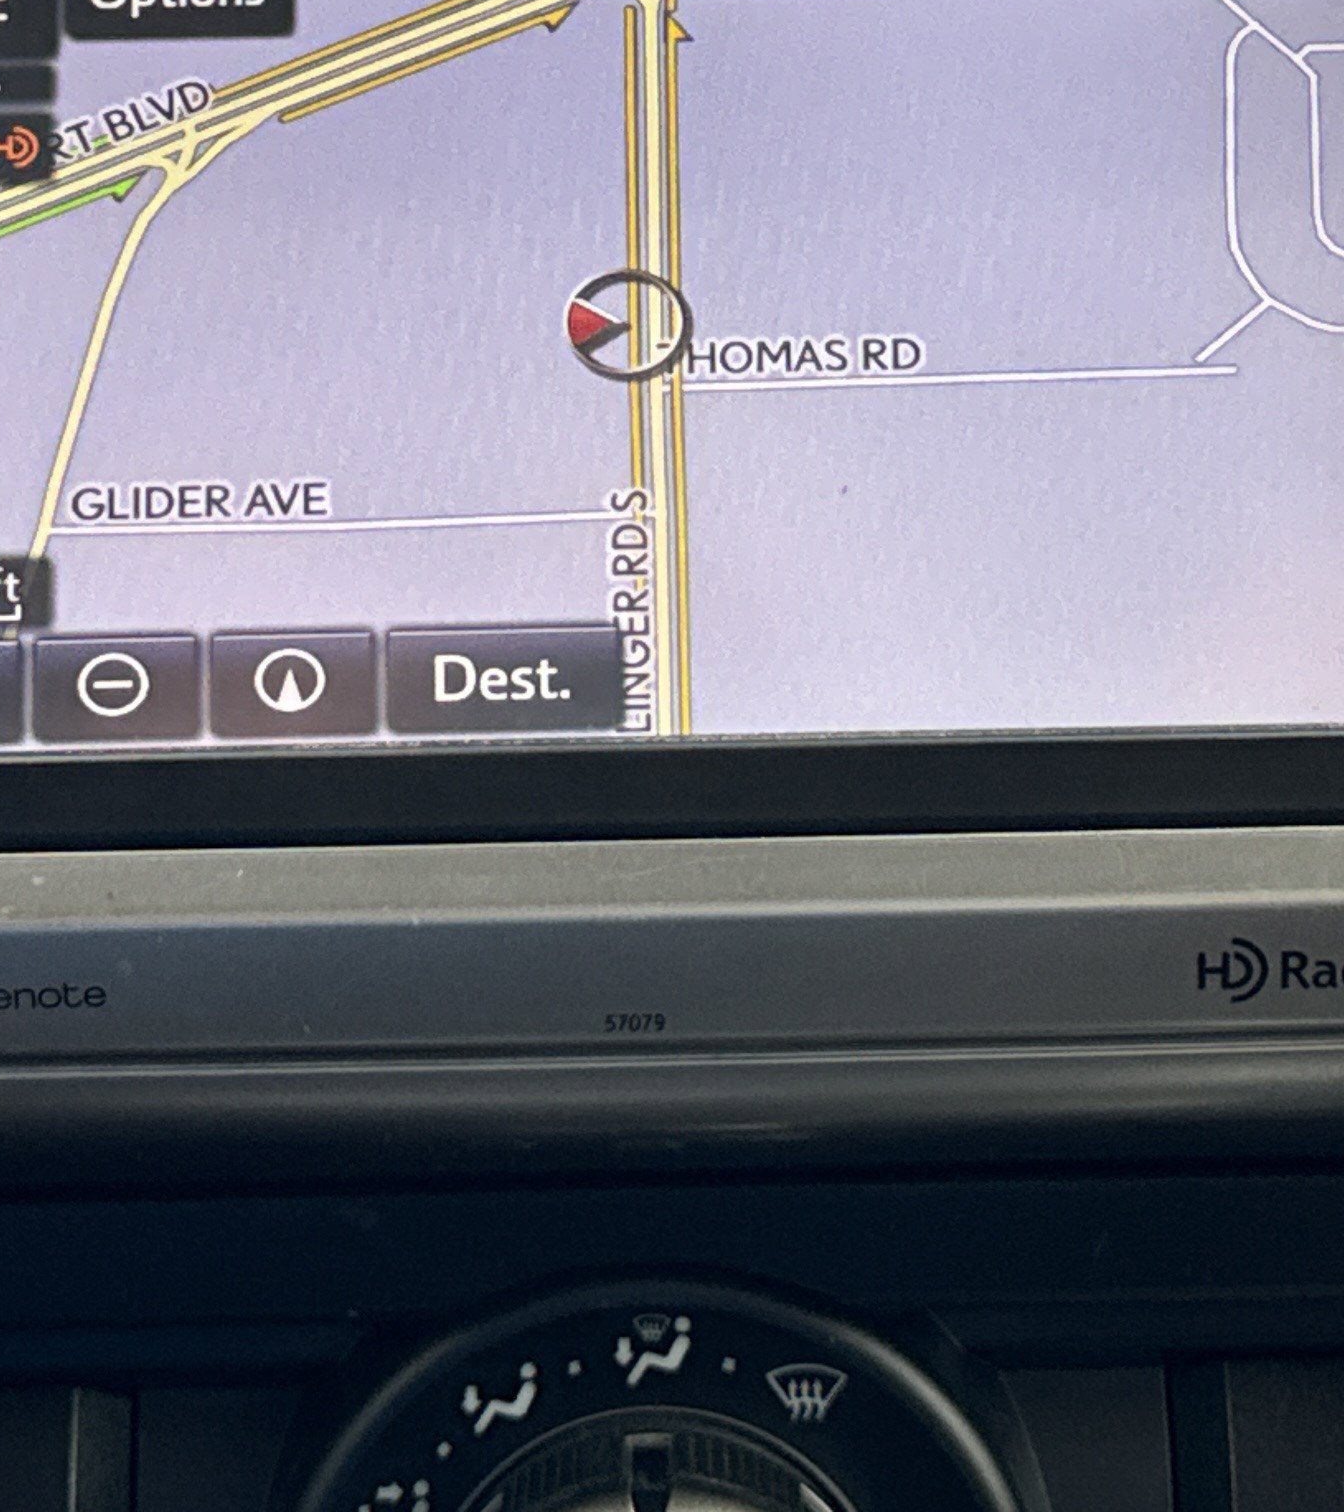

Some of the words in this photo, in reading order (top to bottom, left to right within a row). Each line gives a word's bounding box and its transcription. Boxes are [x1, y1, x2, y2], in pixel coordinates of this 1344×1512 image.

[102, 80, 211, 143] BLVD
[862, 338, 921, 371] RD
[72, 488, 232, 520] GLIDER
[244, 484, 328, 515] AVE
[610, 490, 648, 512] S
[611, 523, 649, 577] RD
[434, 656, 571, 703] Dest.
